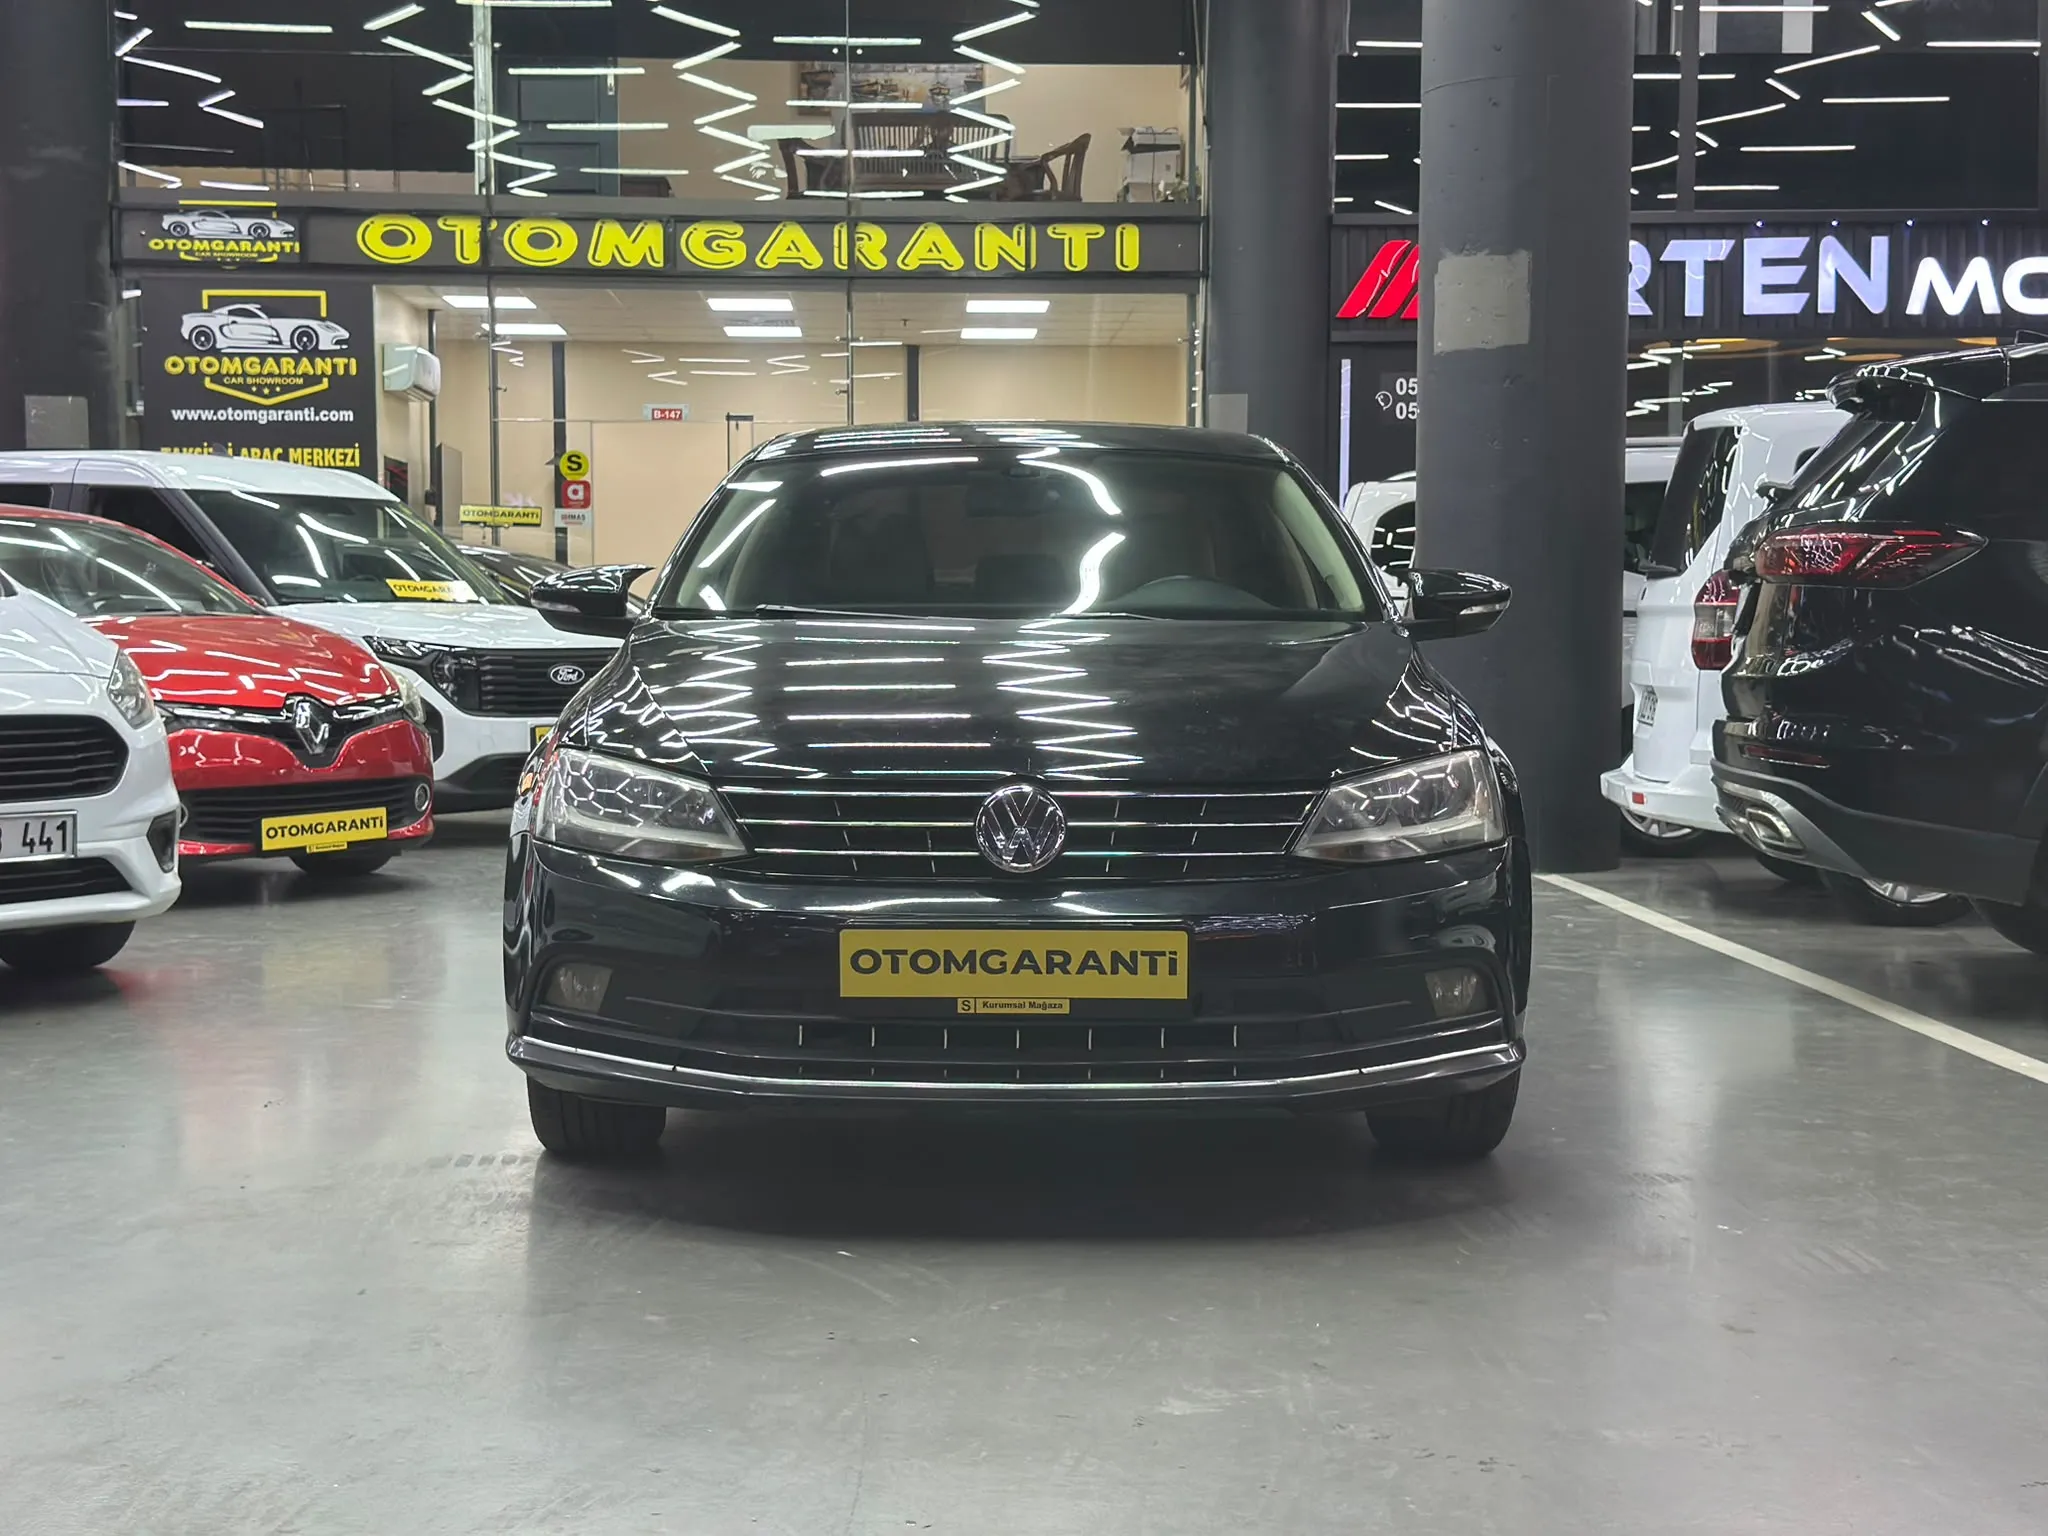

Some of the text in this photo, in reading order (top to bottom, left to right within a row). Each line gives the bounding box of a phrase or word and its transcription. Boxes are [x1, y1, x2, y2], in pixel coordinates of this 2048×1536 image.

[149, 238, 300, 253] OTOMGARANTI
[357, 213, 1139, 272] OTOMGARANTI
[164, 356, 357, 376] OTOMGARANTI
[223, 377, 304, 385] CAR SHOWROOM
[171, 407, 354, 424] www.otomgaranti.com
[653, 410, 681, 419] B-147
[1395, 402, 1420, 420] 05
[288, 442, 360, 468] MERKEZİ
[567, 454, 582, 471] S
[22, 820, 68, 853] 441
[982, 1001, 1026, 1009] Kurumsal
[1028, 1001, 1064, 1011] Mağaza
